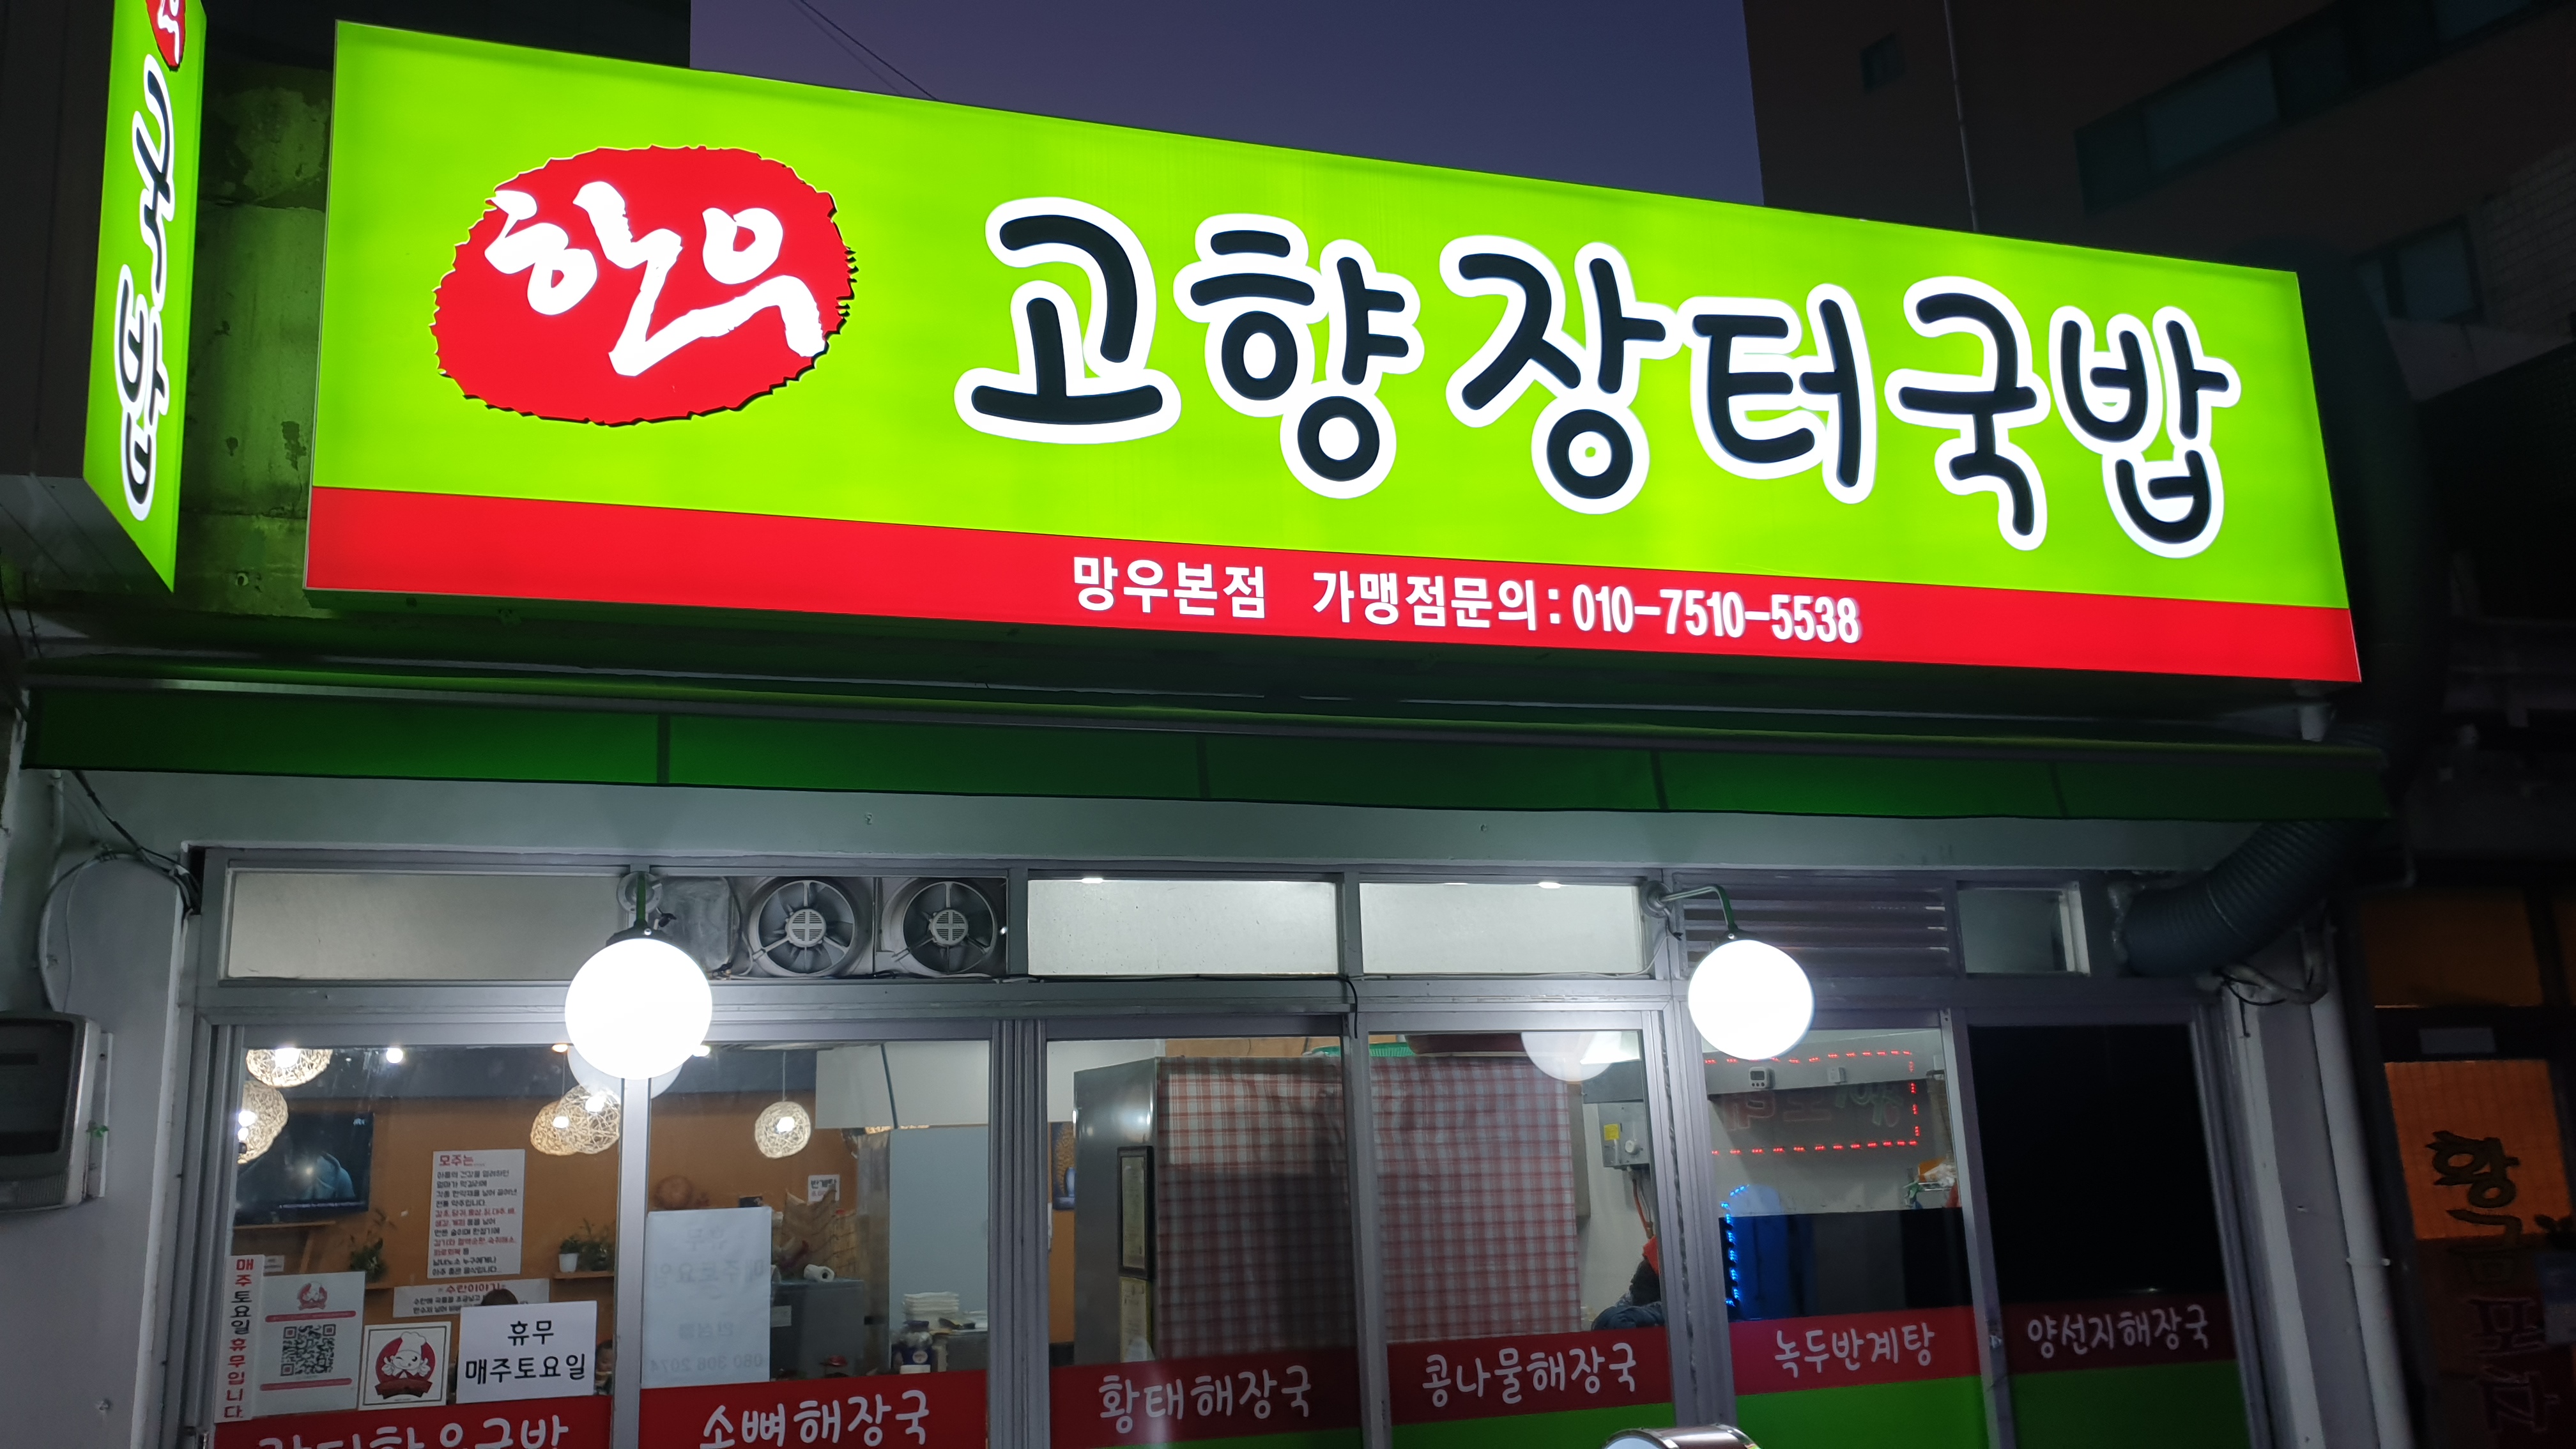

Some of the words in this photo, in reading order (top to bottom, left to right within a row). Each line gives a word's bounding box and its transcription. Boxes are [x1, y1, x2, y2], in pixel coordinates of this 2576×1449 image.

[115, 54, 176, 520] 국밥
[484, 181, 824, 376] 한우
[955, 196, 2241, 558] 고향장터국밥
[1073, 555, 1266, 618] 망우본점
[507, 1320, 555, 1346] 휴무
[1774, 1322, 1936, 1378] 녹두반계탕
[2027, 1303, 2209, 1359] 양선지해장국
[464, 1353, 585, 1385] 매주토요일
[1098, 1365, 1312, 1433] 황태해장국
[1422, 1342, 1637, 1407] 콩나물해장국
[700, 1390, 930, 1449] 소뼈해장국
